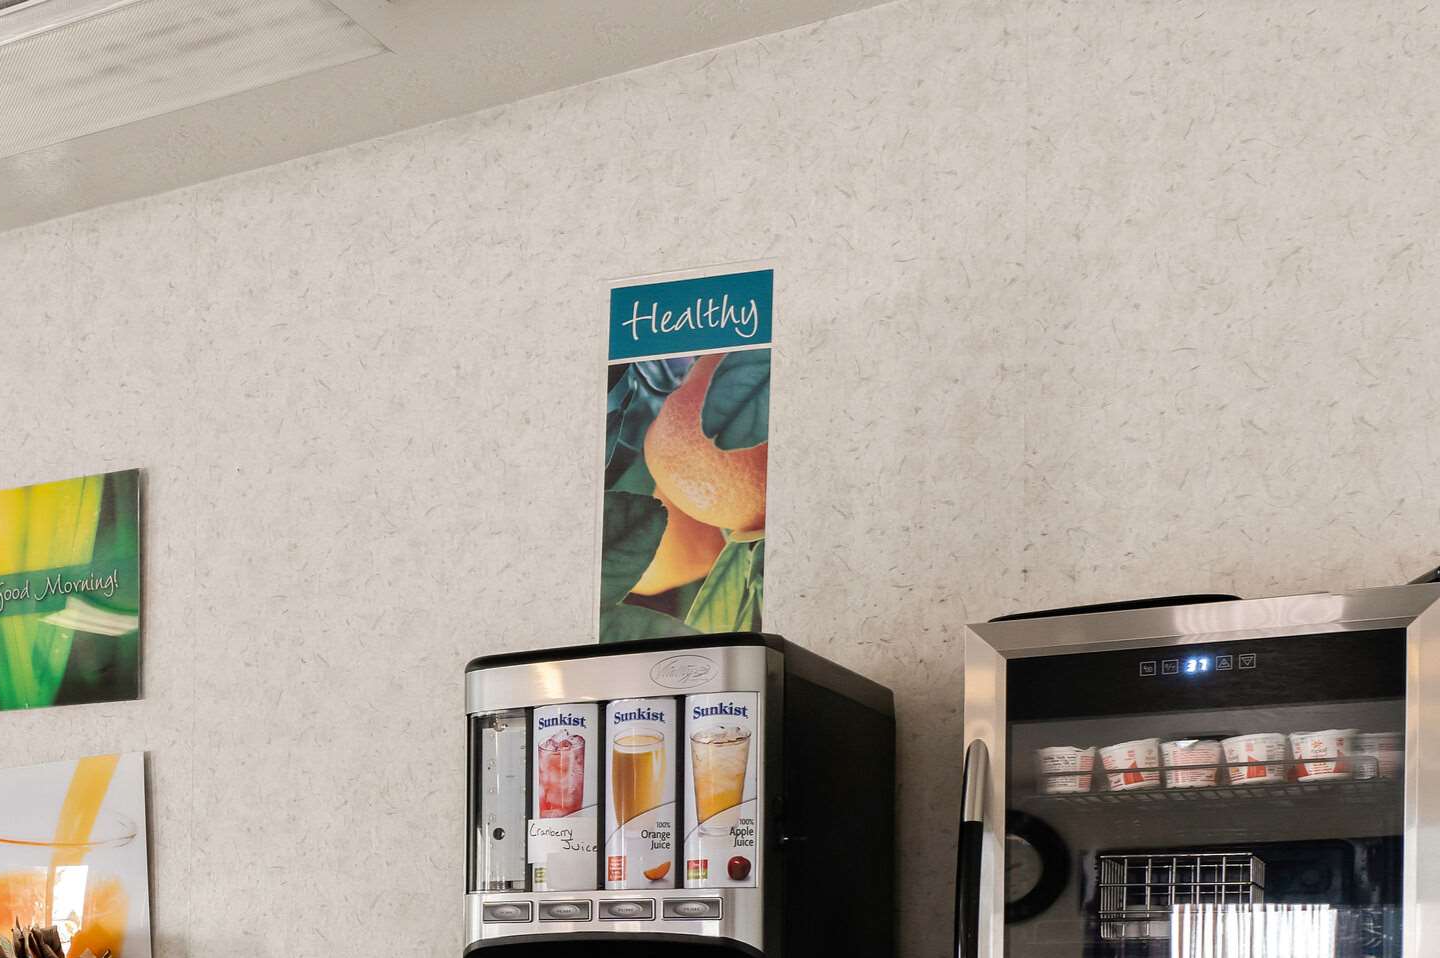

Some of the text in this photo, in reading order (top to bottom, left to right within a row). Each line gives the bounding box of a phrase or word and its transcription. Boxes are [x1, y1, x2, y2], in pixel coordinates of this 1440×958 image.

[622, 294, 758, 341] Healthy
[34, 569, 119, 601] Morning!
[614, 708, 666, 725] Sunkist
[693, 702, 749, 720] Sunkist
[538, 713, 587, 730] Sunkist
[529, 823, 573, 840] Cranberry
[641, 829, 671, 841] Orange
[729, 826, 754, 838] Apple
[561, 839, 598, 853] Juice
[650, 840, 671, 850] Juice
[733, 837, 754, 847] Juice
